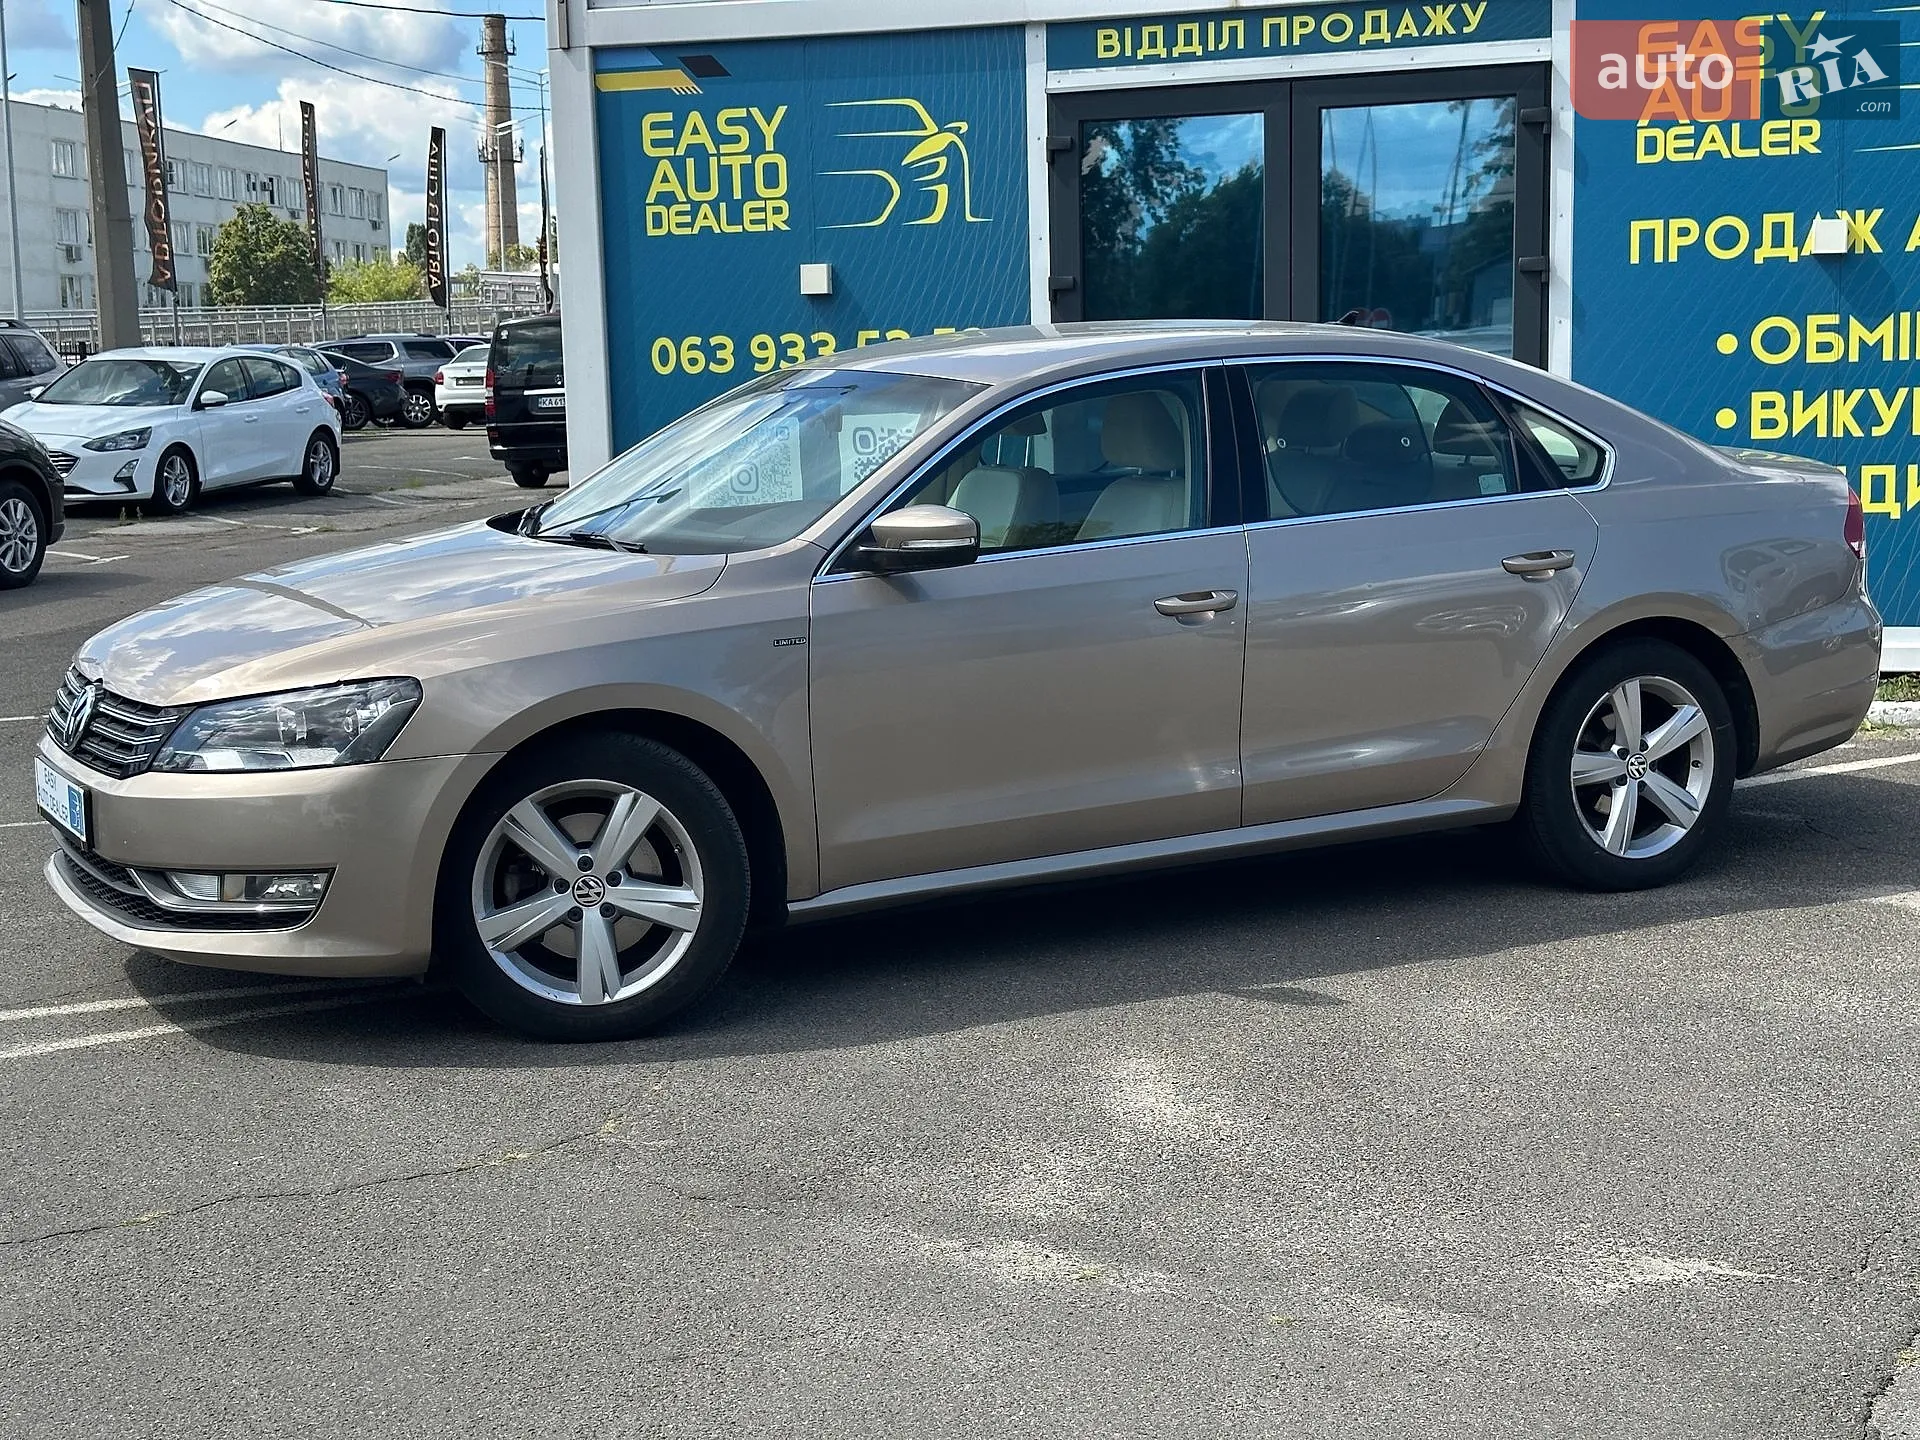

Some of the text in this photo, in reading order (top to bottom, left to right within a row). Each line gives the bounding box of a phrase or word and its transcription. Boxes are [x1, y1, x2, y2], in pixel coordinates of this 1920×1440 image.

[1096, 1, 1487, 59] ВІДДІЛ ПРОДАЖУ
[642, 105, 788, 157] EASY
[1637, 119, 1822, 164] DEALER
[646, 153, 789, 203] AUTO
[646, 199, 791, 236] DEALER
[651, 336, 735, 375] 063
[1751, 312, 1920, 365] ОБМІ
[1751, 387, 1920, 440] ВИКУ
[774, 638, 806, 646] LIMITED
